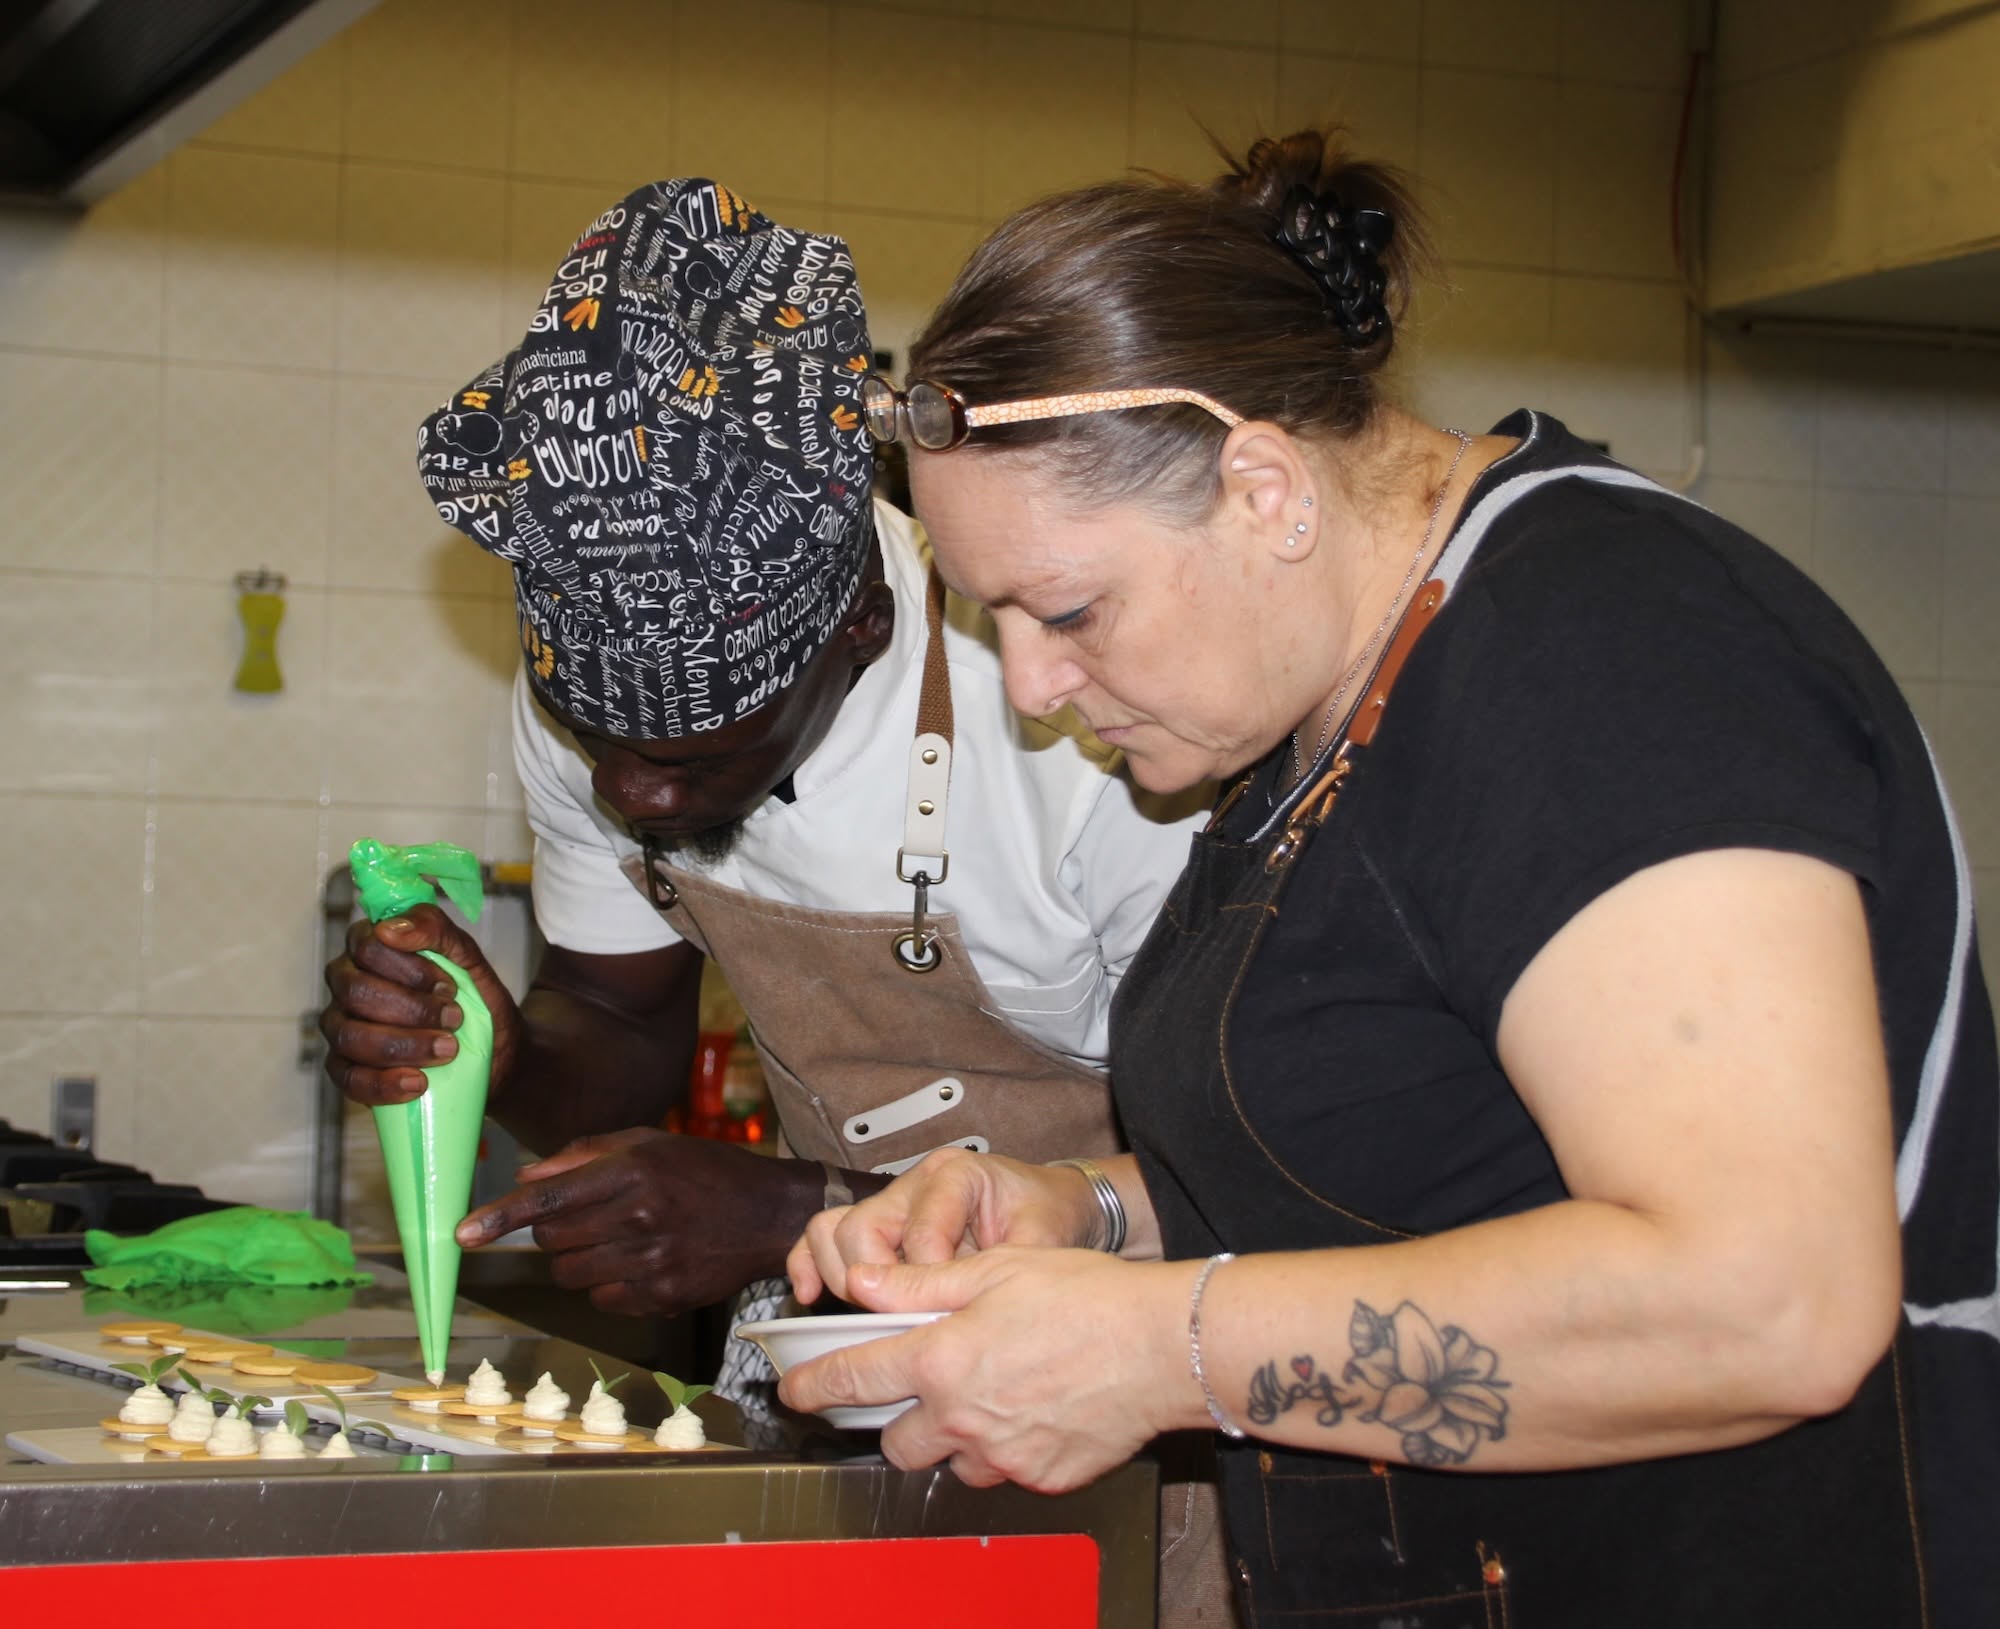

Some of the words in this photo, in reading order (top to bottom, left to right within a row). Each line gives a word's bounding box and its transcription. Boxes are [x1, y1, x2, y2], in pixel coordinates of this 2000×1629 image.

[543, 273, 608, 305] FOR
[557, 249, 608, 281] CHI
[715, 459, 787, 554] Bruschetta
[656, 636, 688, 739] Bruschetta
[680, 622, 720, 715] Menu
